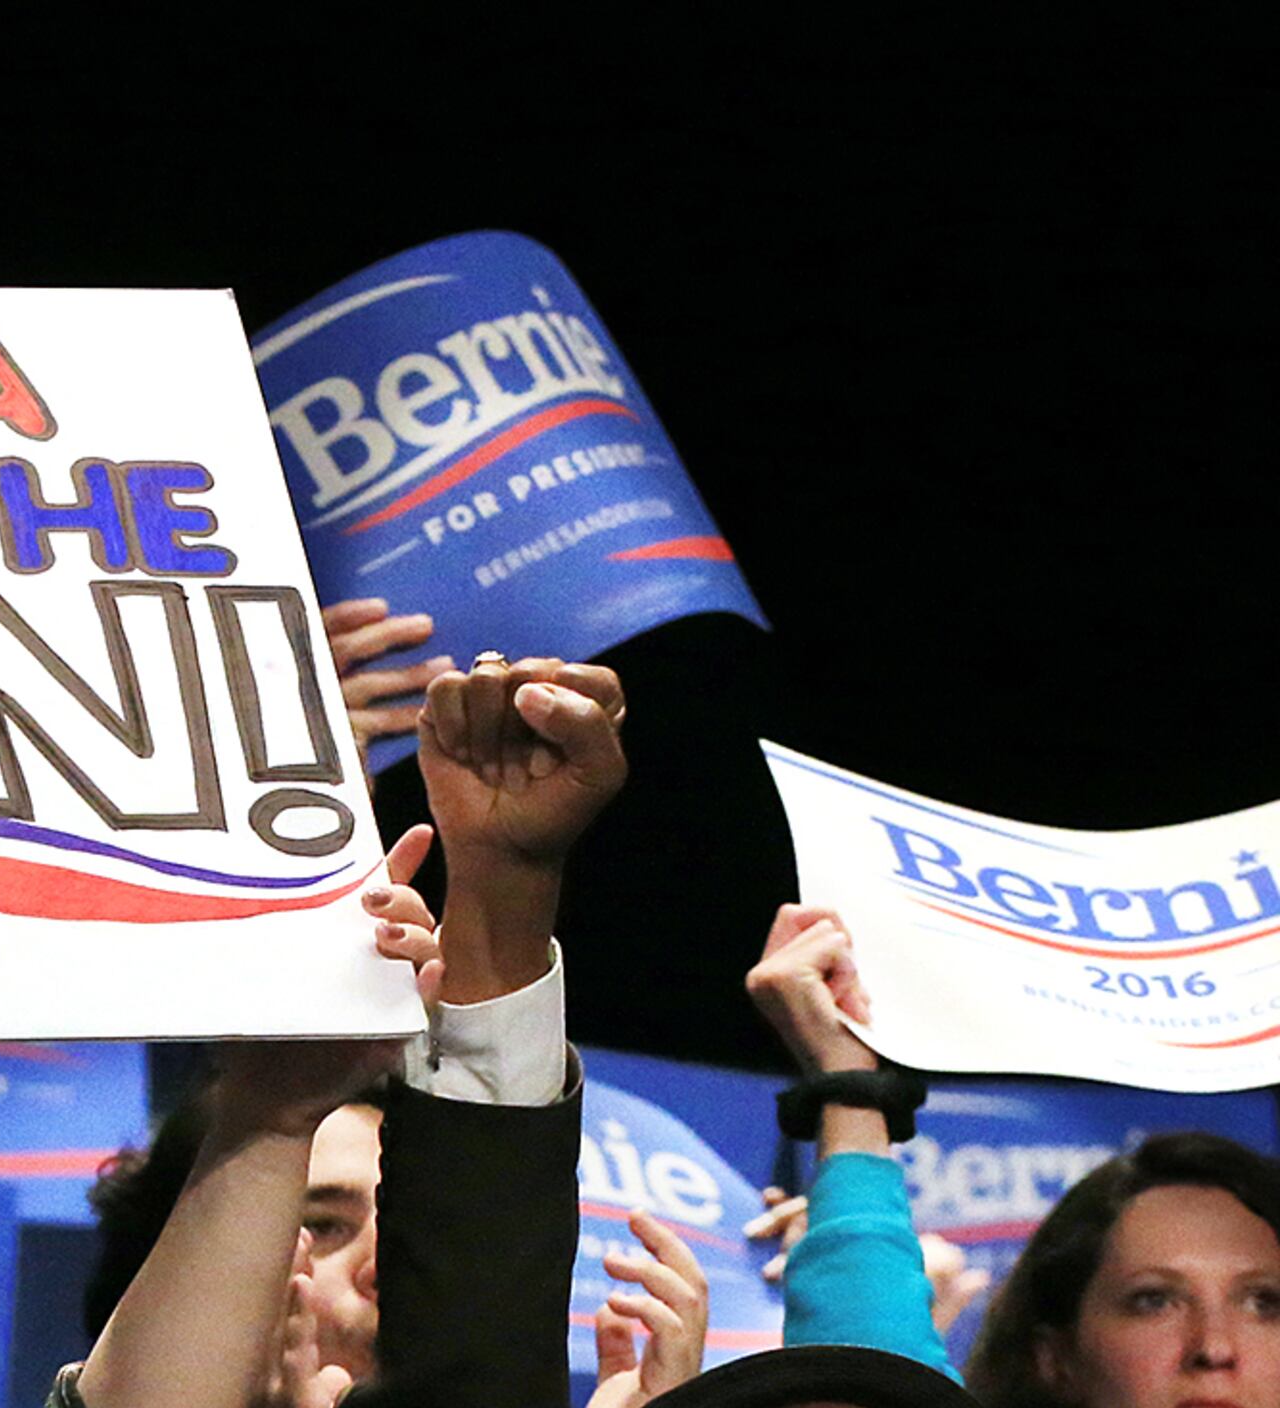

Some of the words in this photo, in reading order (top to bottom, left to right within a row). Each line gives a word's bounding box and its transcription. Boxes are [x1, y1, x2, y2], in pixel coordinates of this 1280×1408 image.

[268, 285, 624, 510] Bernie
[423, 492, 502, 546] FOR
[870, 814, 1280, 943] Berni
[1083, 964, 1217, 999] 2016
